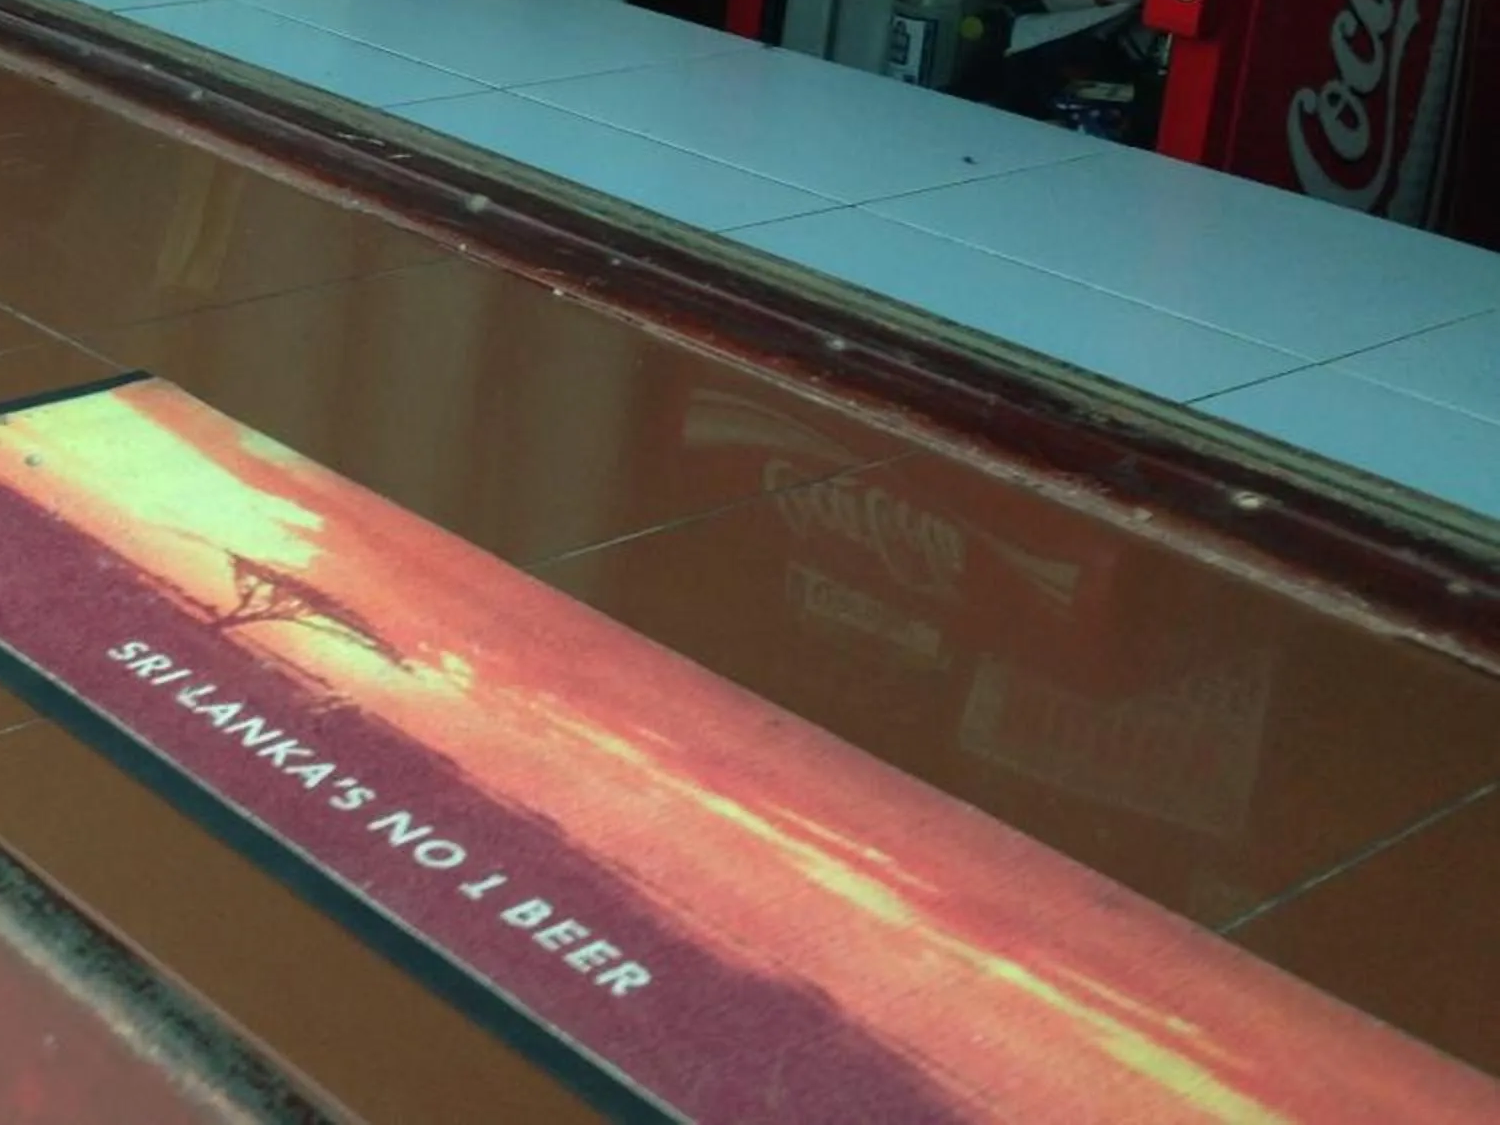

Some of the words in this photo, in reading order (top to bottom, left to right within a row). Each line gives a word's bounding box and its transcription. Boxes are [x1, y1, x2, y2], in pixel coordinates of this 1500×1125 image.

[106, 640, 189, 686] SRI
[176, 678, 375, 812] LANKA'S
[367, 810, 467, 870] NO
[500, 897, 653, 997] BEER
